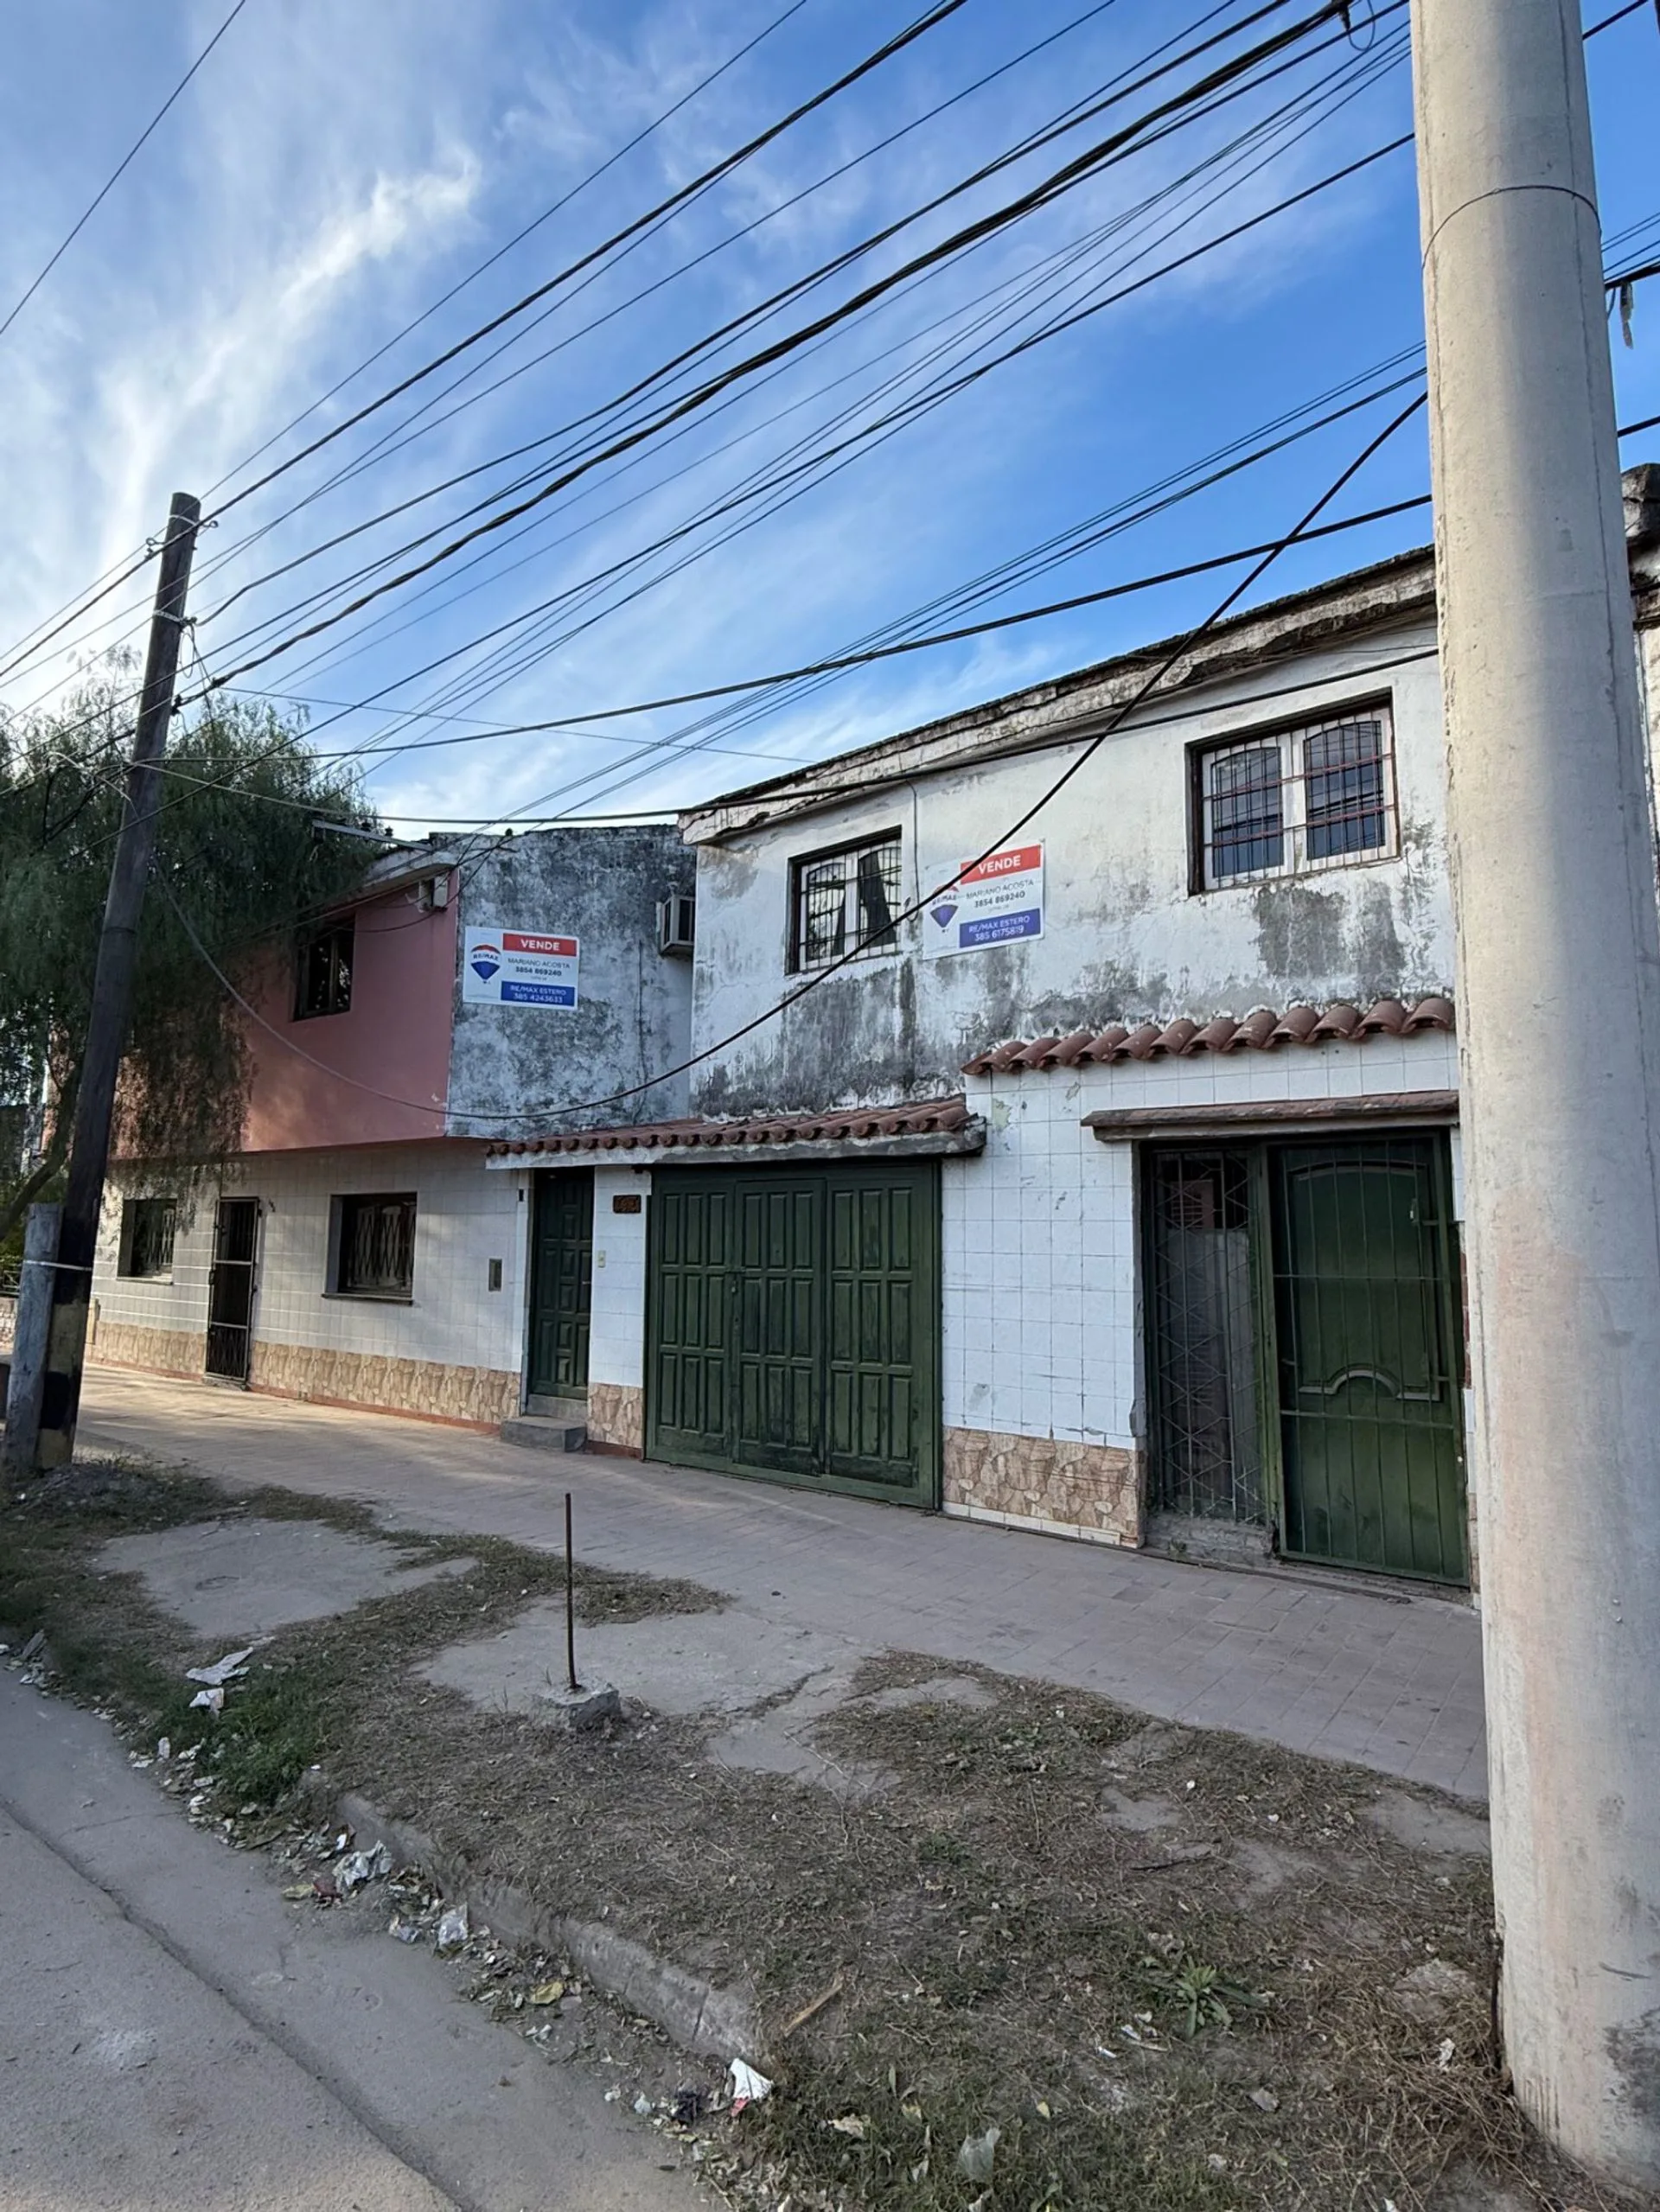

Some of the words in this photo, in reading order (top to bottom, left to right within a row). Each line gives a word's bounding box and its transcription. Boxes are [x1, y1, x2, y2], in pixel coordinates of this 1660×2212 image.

[978, 855, 1021, 874] VENDE
[966, 886, 1001, 898] MARIANO
[1003, 879, 1033, 891] ACOSTA
[969, 921, 999, 933] RE/MAX
[1000, 915, 1030, 928] ESTERO
[974, 933, 990, 941] 385
[521, 939, 560, 951] VENDE
[508, 958, 541, 966] MARIANO
[540, 987, 566, 996] ESTERO
